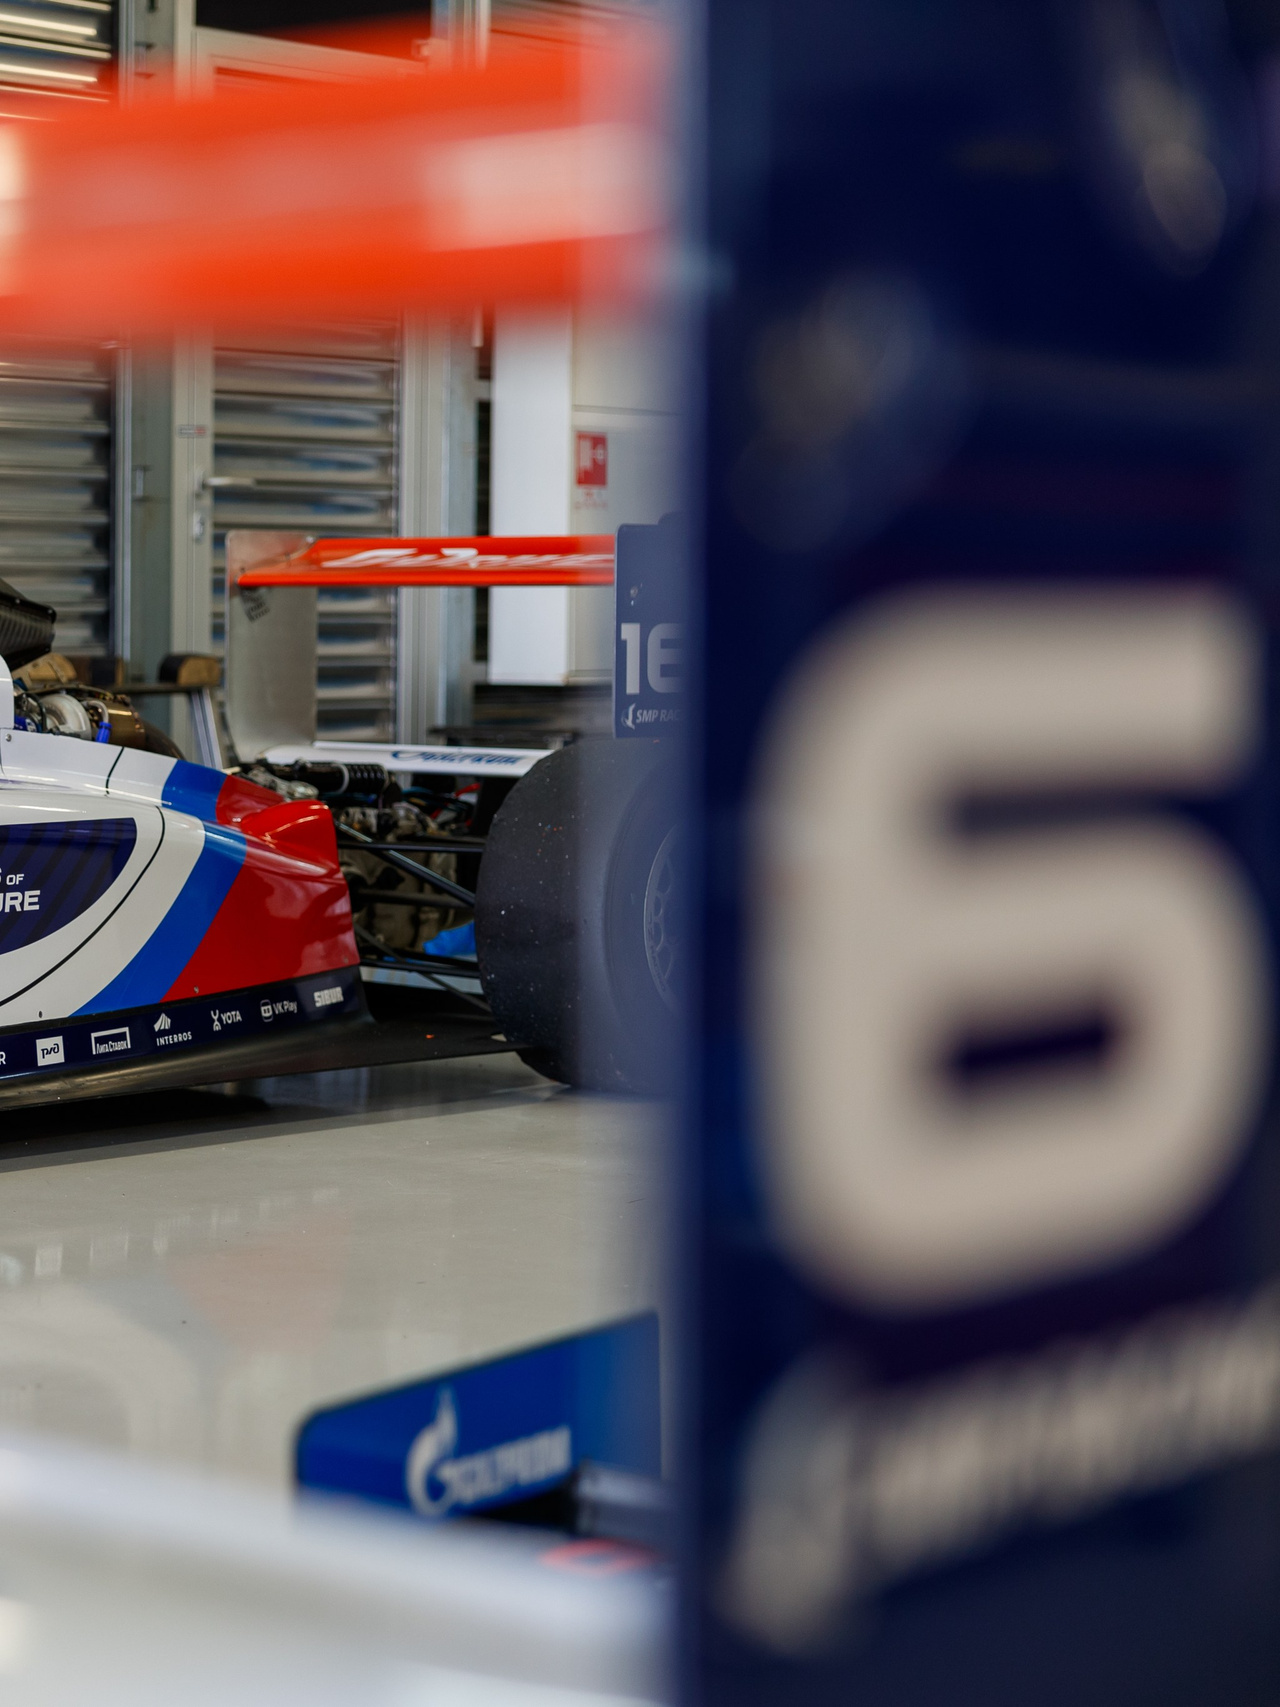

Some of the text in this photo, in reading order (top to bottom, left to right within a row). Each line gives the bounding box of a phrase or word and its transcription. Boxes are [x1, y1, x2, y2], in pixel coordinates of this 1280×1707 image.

[636, 710, 659, 723] SMP
[6, 873, 24, 886] OF
[750, 583, 1270, 1318] 6
[313, 986, 344, 1007] SIBUR
[273, 1000, 298, 1015] VK Play
[220, 1010, 243, 1025] YOTA
[156, 1031, 193, 1047] INTERROS
